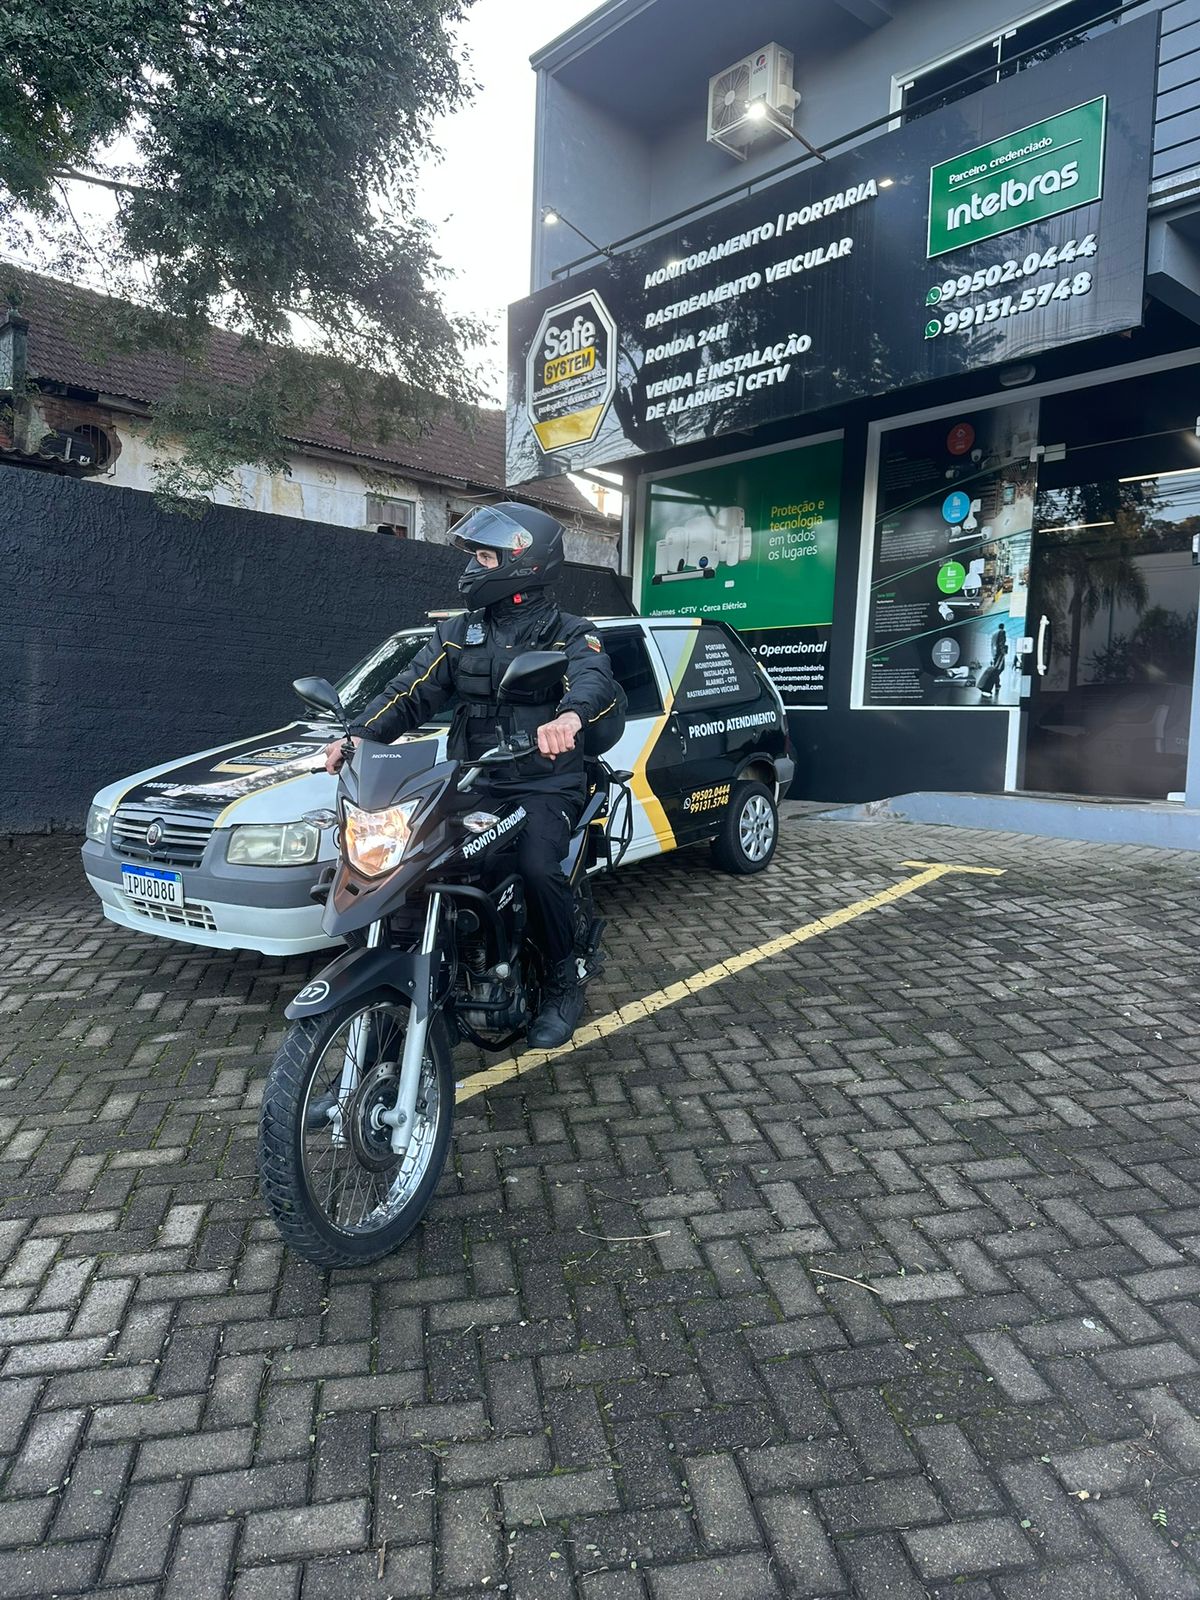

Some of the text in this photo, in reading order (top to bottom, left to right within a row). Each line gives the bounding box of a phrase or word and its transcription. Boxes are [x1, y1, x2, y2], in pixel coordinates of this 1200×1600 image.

[949, 136, 1053, 184] Parceiro credenciado
[947, 160, 1080, 230] intelbras
[644, 222, 774, 290] MONITORAMENTO
[786, 179, 878, 231] PORTARIA
[941, 234, 1098, 301] 99502.0444
[645, 237, 854, 329] RASTREAMENTO VEICULAR
[943, 272, 1092, 334] 99131.5748
[544, 316, 596, 360] Safe
[644, 322, 729, 364] RONDA 24H
[546, 351, 591, 380] SYSTEM
[646, 333, 812, 399] VENDA E INSTALAÇÃO
[646, 402, 666, 421] DE
[666, 381, 735, 415] ALARMES
[746, 364, 790, 391] CFTV
[770, 513, 823, 532] tecnologia
[771, 500, 825, 518] Proteção e
[769, 530, 816, 546] em todos
[768, 545, 818, 560] os lugares
[702, 604, 721, 612] Cerca
[722, 601, 747, 610] Elétrica
[760, 640, 827, 657] Operacional
[695, 660, 732, 670] MONITORAMENTO
[686, 687, 720, 698] RASTREAMENTO
[688, 710, 776, 738] PRONTO ATENDIMENTO
[690, 794, 729, 813] 99131.5748
[692, 784, 730, 802] 99502.0444
[462, 829, 496, 859] PRONTO
[128, 875, 175, 901] IPU8D80
[299, 987, 324, 998] 07
